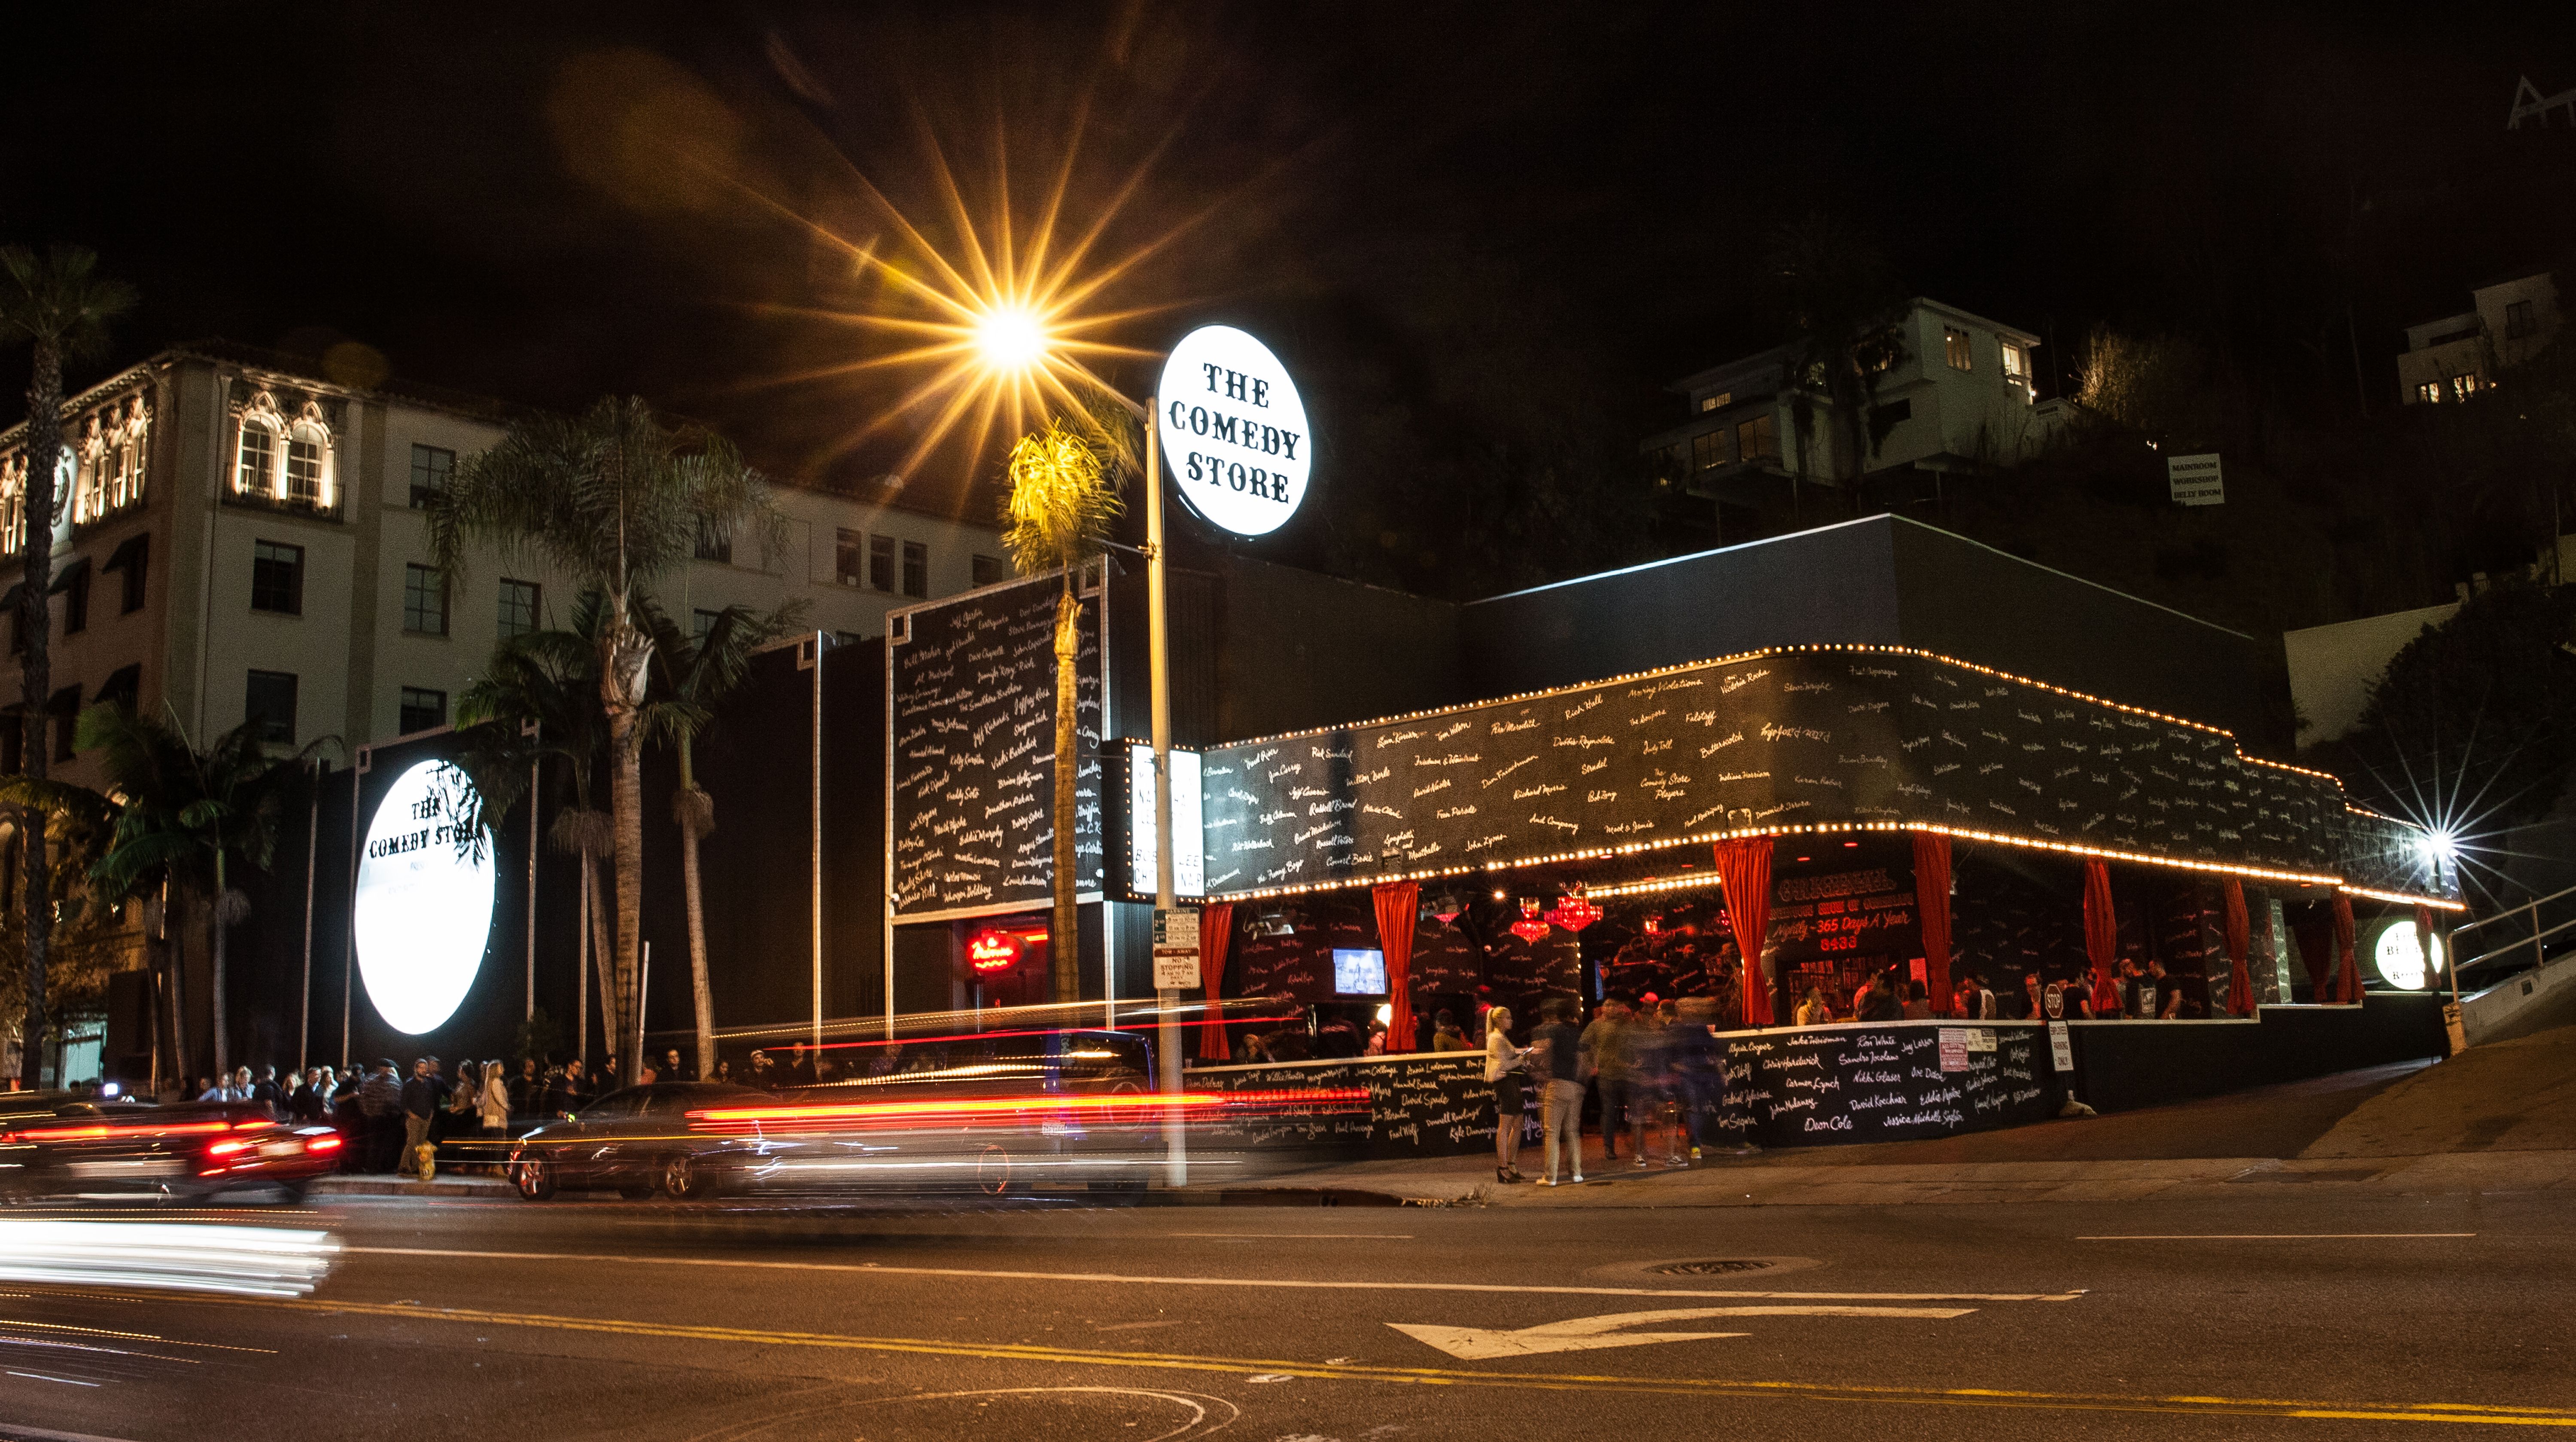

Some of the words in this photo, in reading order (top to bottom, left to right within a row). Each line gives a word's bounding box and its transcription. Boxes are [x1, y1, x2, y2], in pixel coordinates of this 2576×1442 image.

[1204, 363, 1269, 408] THE
[1169, 401, 1300, 460] COMEDY
[1186, 452, 1289, 504] STORE
[2173, 475, 2219, 485] WORKSHOP
[1658, 679, 1703, 692] Violations
[1699, 731, 1744, 759] Butterscotch
[1640, 777, 1666, 789] Comedy
[1668, 773, 1691, 785] Store
[412, 797, 440, 820] THE
[370, 829, 429, 858] COMEDY
[1465, 840, 1482, 852] John
[1817, 918, 1838, 933] 365
[1821, 936, 1857, 951] 8433
[2047, 993, 2061, 1009] STOP
[1857, 1035, 1872, 1048] Ron
[1869, 1034, 1896, 1046] White
[1780, 1053, 1824, 1072] Hardwick
[1813, 1075, 1840, 1094] Lynch
[1853, 1070, 1875, 1082] Nikki
[1876, 1071, 1901, 1083] Glaser
[1401, 1094, 1423, 1106] David
[1849, 1096, 1874, 1111] David
[1830, 1114, 1853, 1130] Cole
